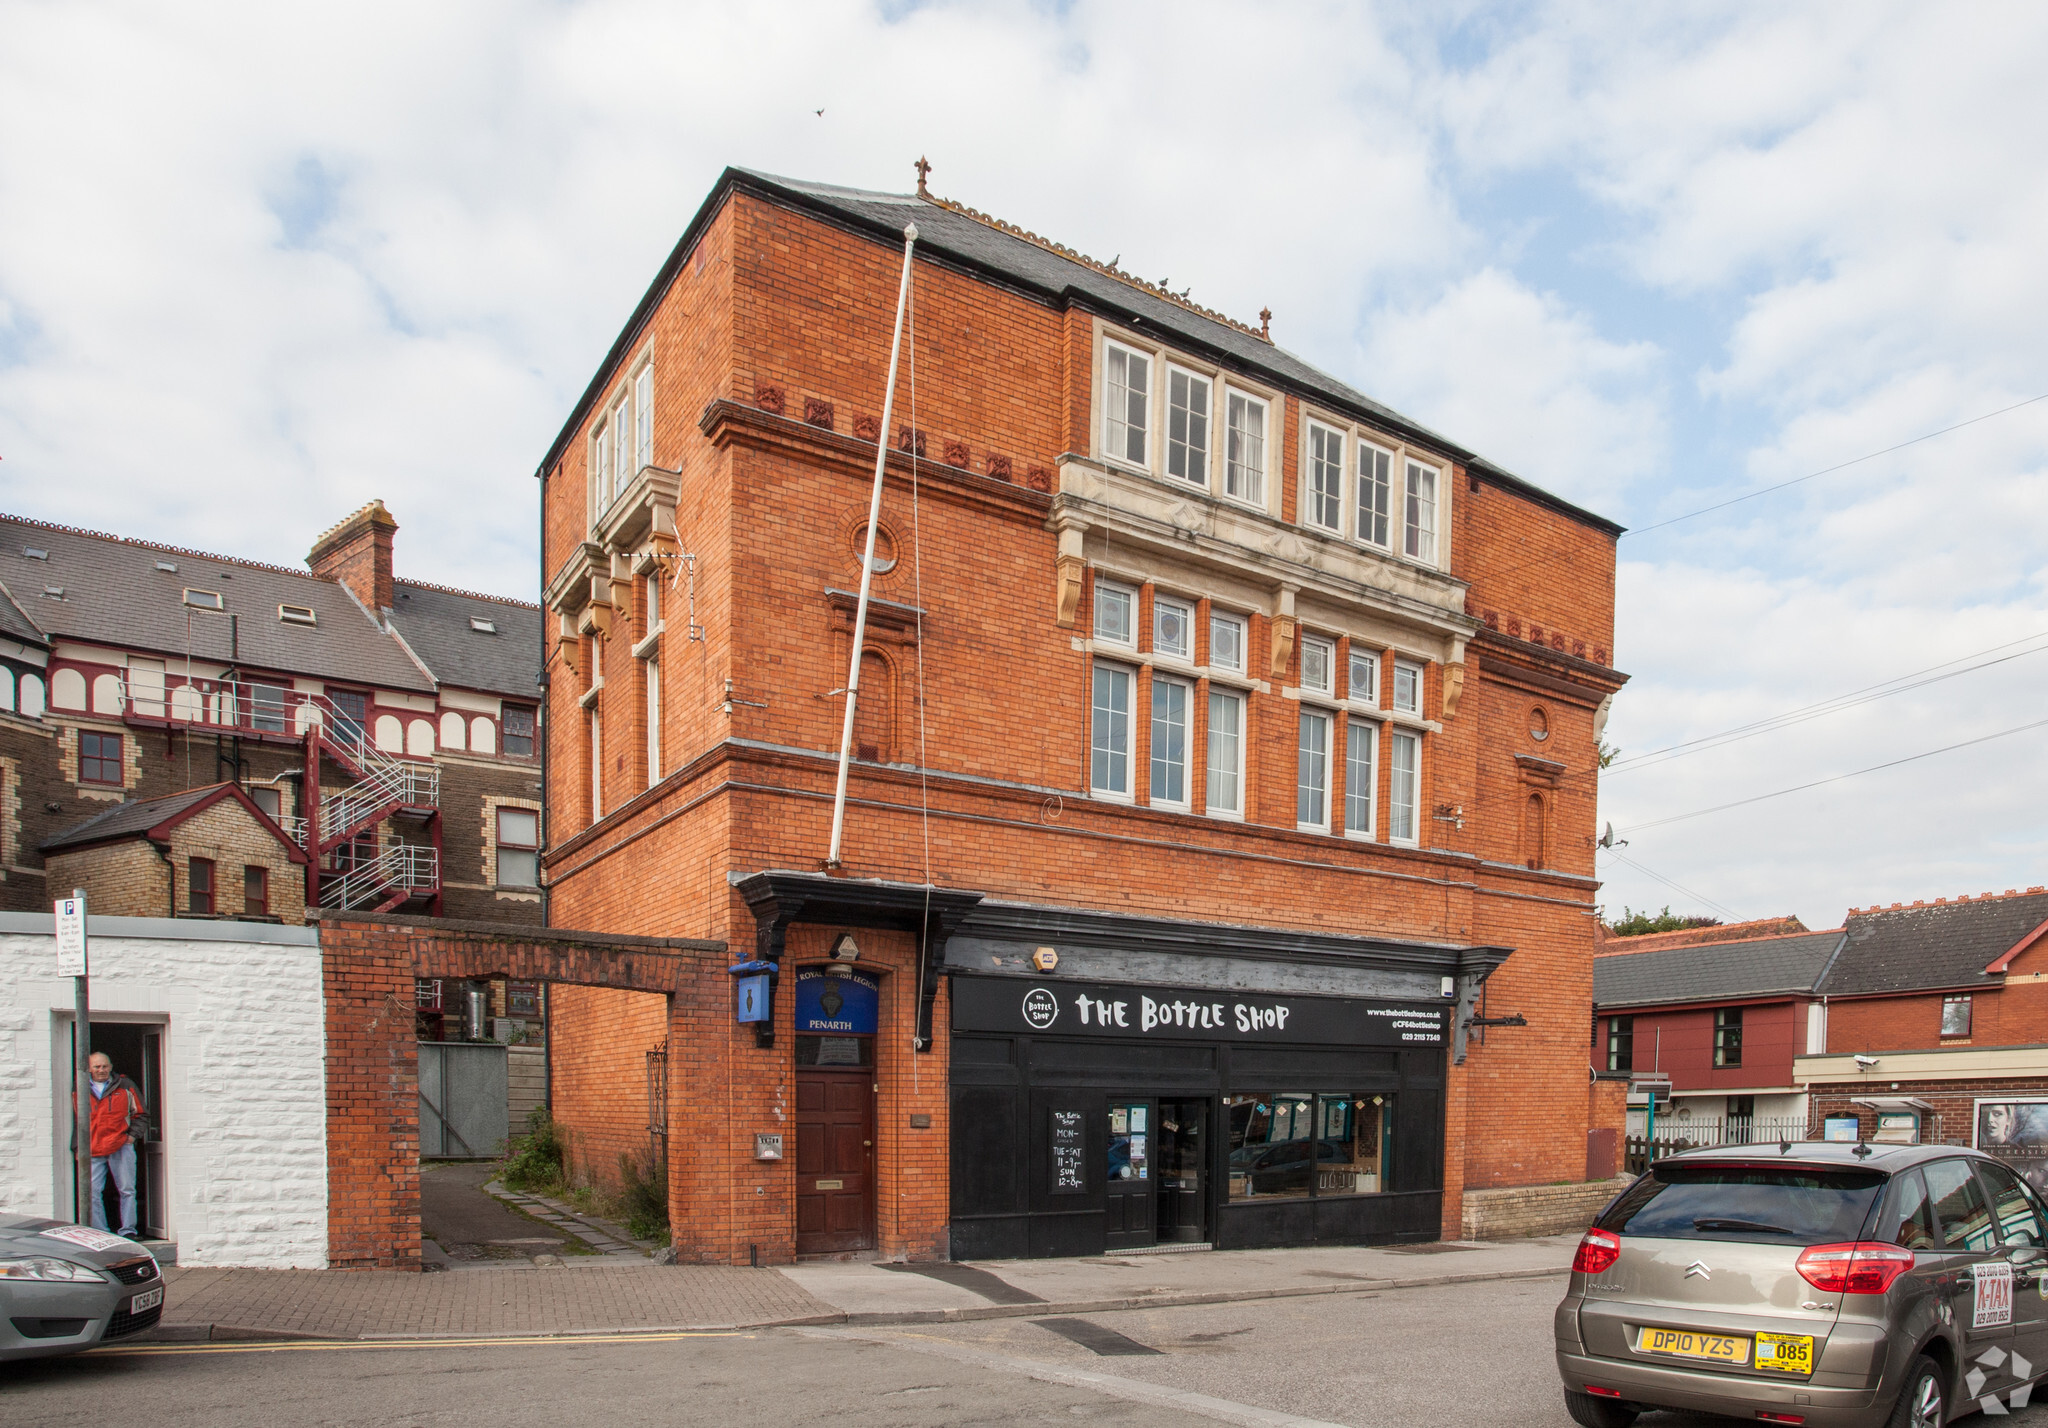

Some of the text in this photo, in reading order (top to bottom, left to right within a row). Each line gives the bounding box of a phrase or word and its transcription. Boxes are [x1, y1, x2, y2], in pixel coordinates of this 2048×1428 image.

[67, 902, 73, 914] P
[800, 971, 822, 980] ROYAL
[854, 976, 878, 991] LEGION
[1028, 1001, 1052, 1012] BOTTLE
[1075, 993, 1289, 1032] THE BOTTLE SHOP
[1032, 1011, 1050, 1020] SHOP
[809, 1020, 852, 1030] PENARTH
[1977, 1278, 2009, 1310] K-TAX
[1652, 1331, 1736, 1356] DP10 YZS
[1777, 1344, 1807, 1360] 085
